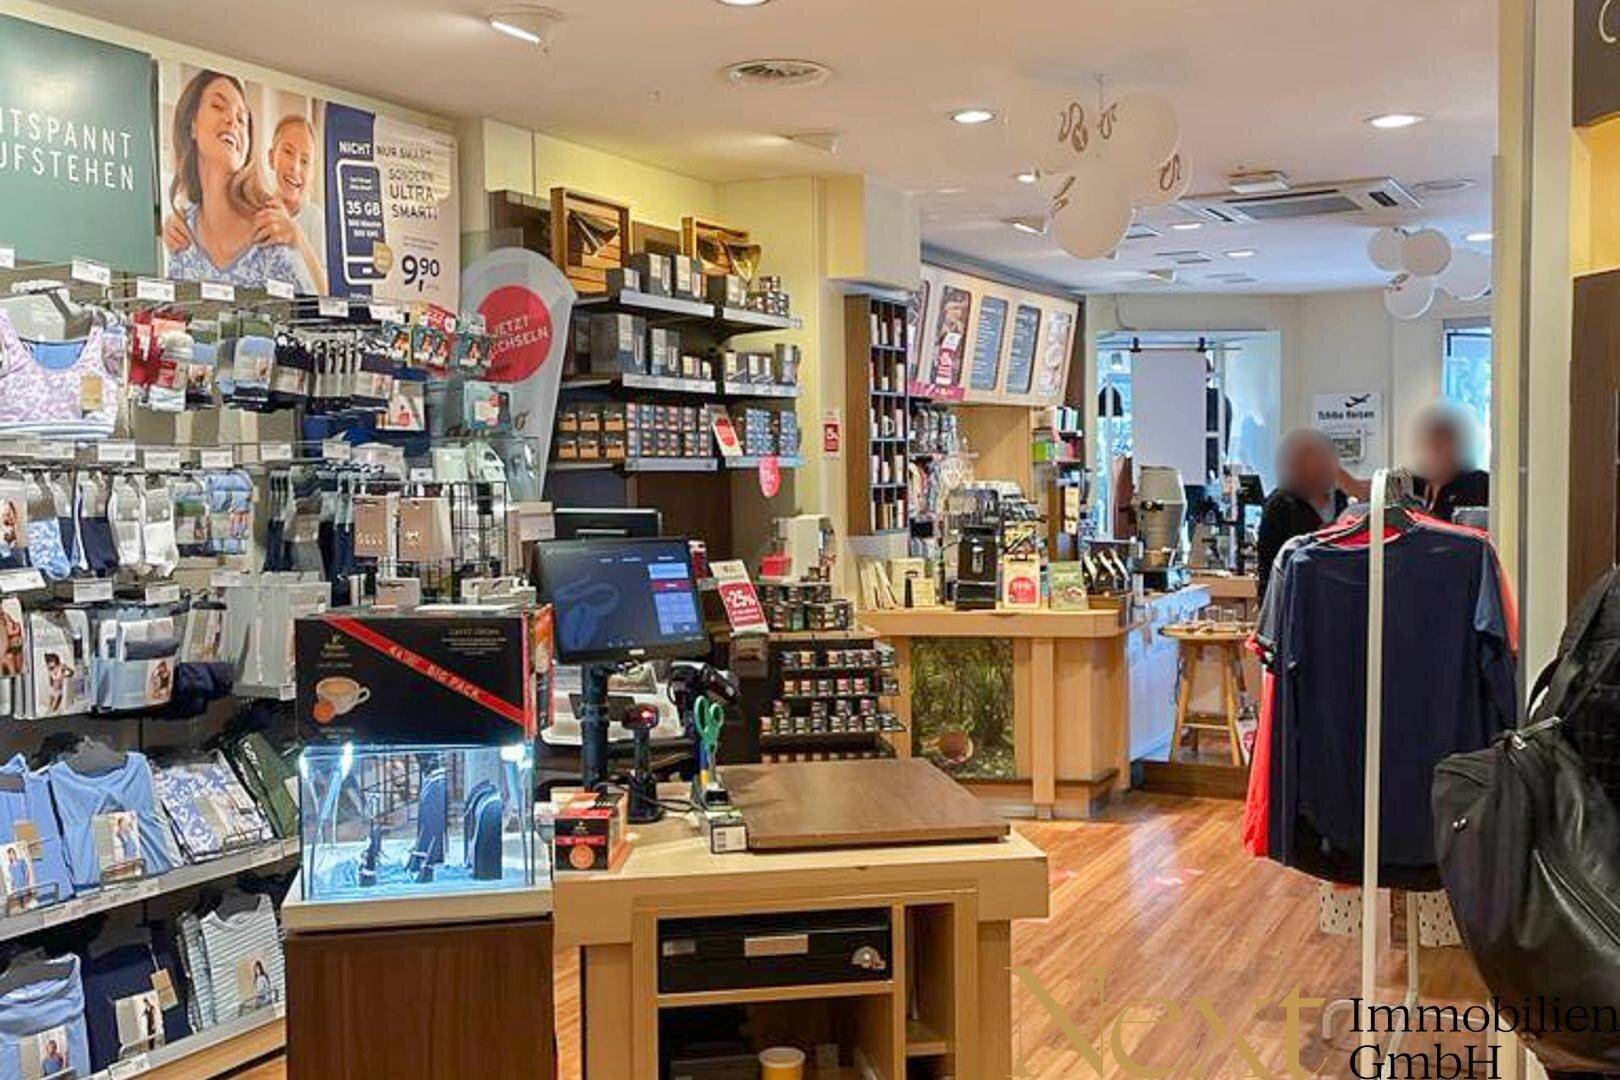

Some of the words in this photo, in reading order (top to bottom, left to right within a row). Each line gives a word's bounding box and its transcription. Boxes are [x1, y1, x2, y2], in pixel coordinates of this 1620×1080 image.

[0, 106, 132, 159] TSPANNT
[339, 141, 371, 155] NICHT
[389, 183, 435, 201] ULTRA
[346, 200, 361, 215] 35
[364, 201, 381, 216] GB
[1318, 410, 1344, 420] Tchibo
